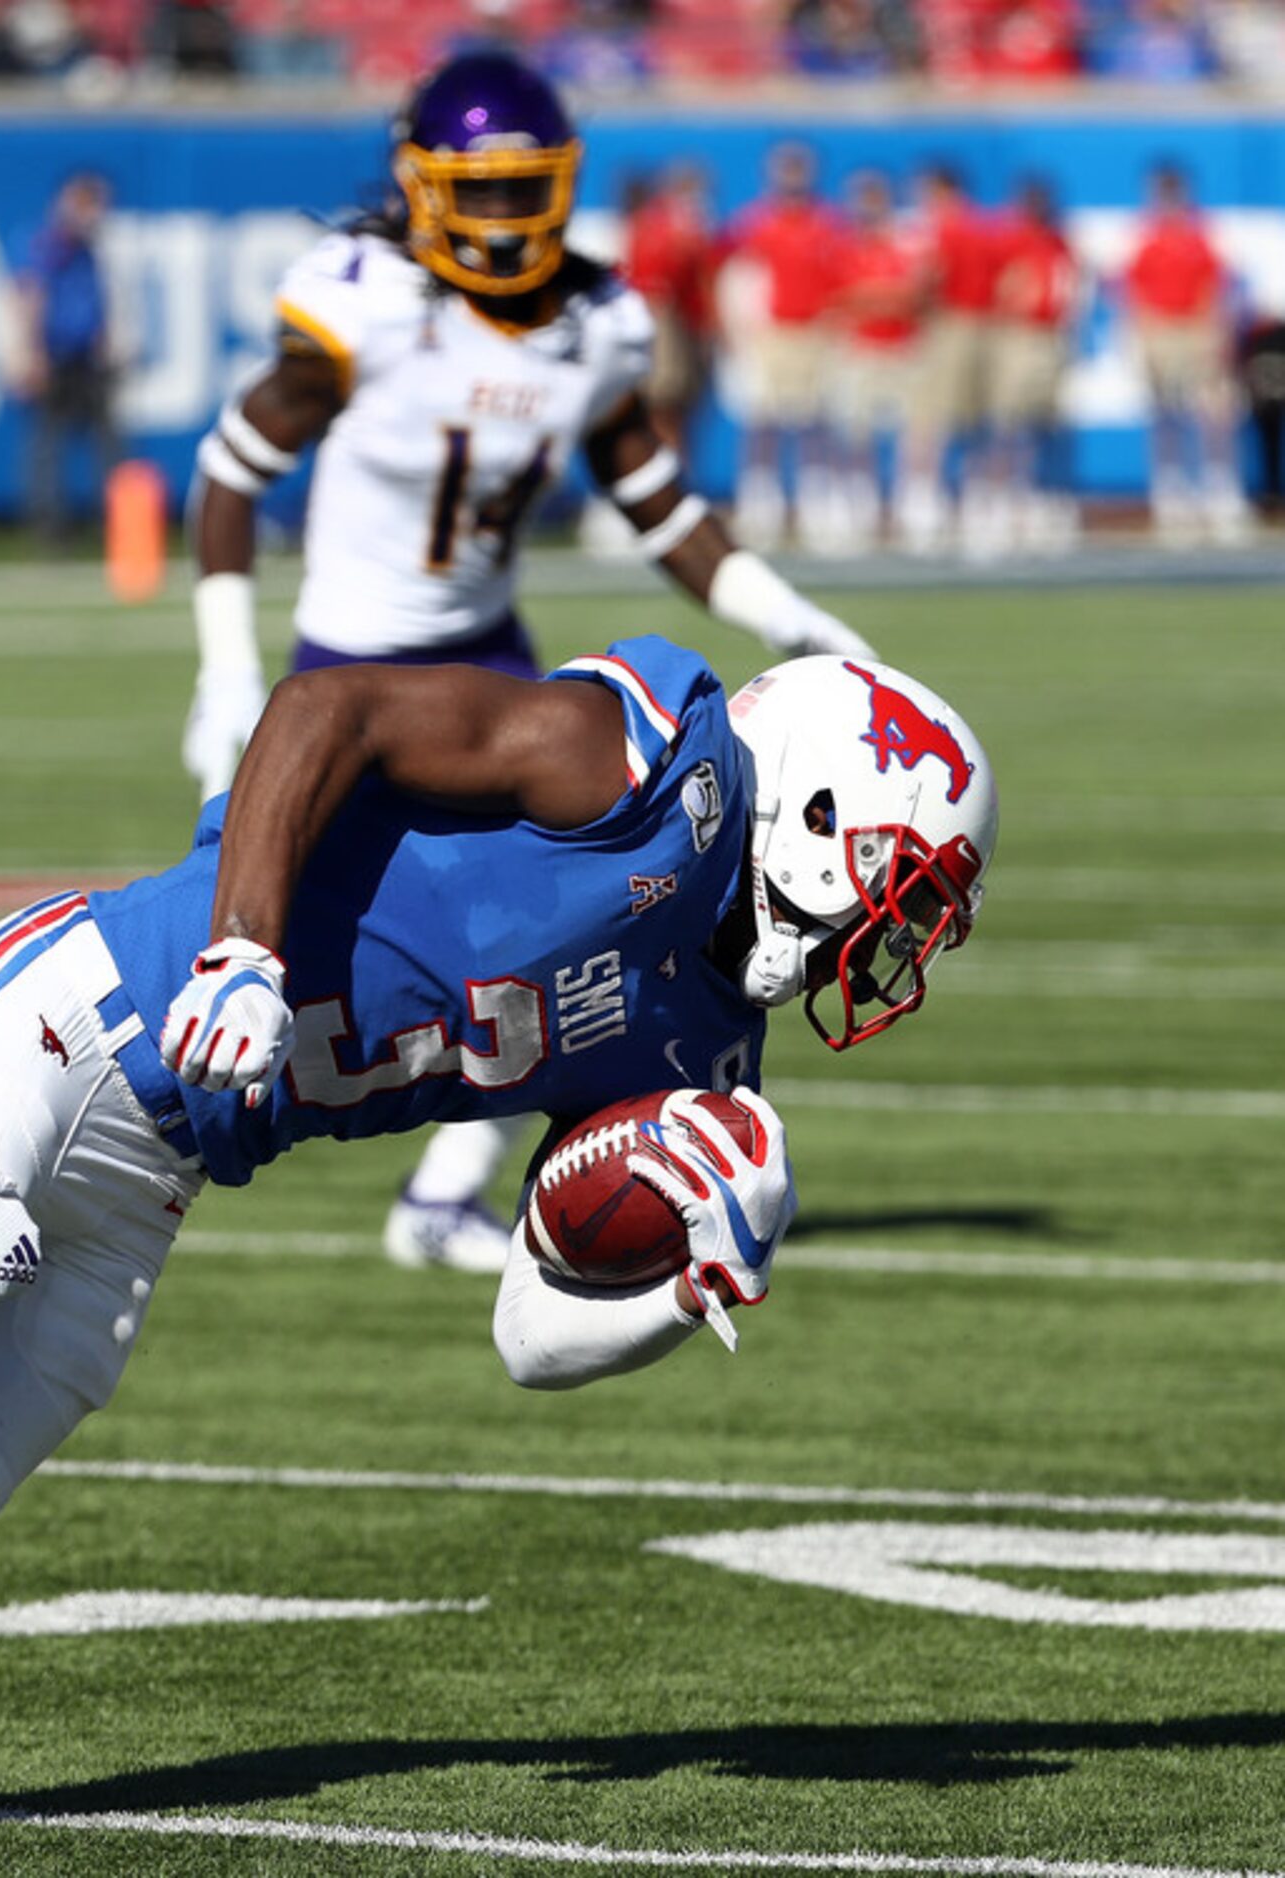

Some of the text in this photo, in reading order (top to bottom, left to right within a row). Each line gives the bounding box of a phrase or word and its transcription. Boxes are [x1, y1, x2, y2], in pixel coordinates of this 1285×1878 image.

[422, 421, 554, 578] 14
[289, 975, 550, 1109] 3
[554, 949, 627, 1055] SMU
